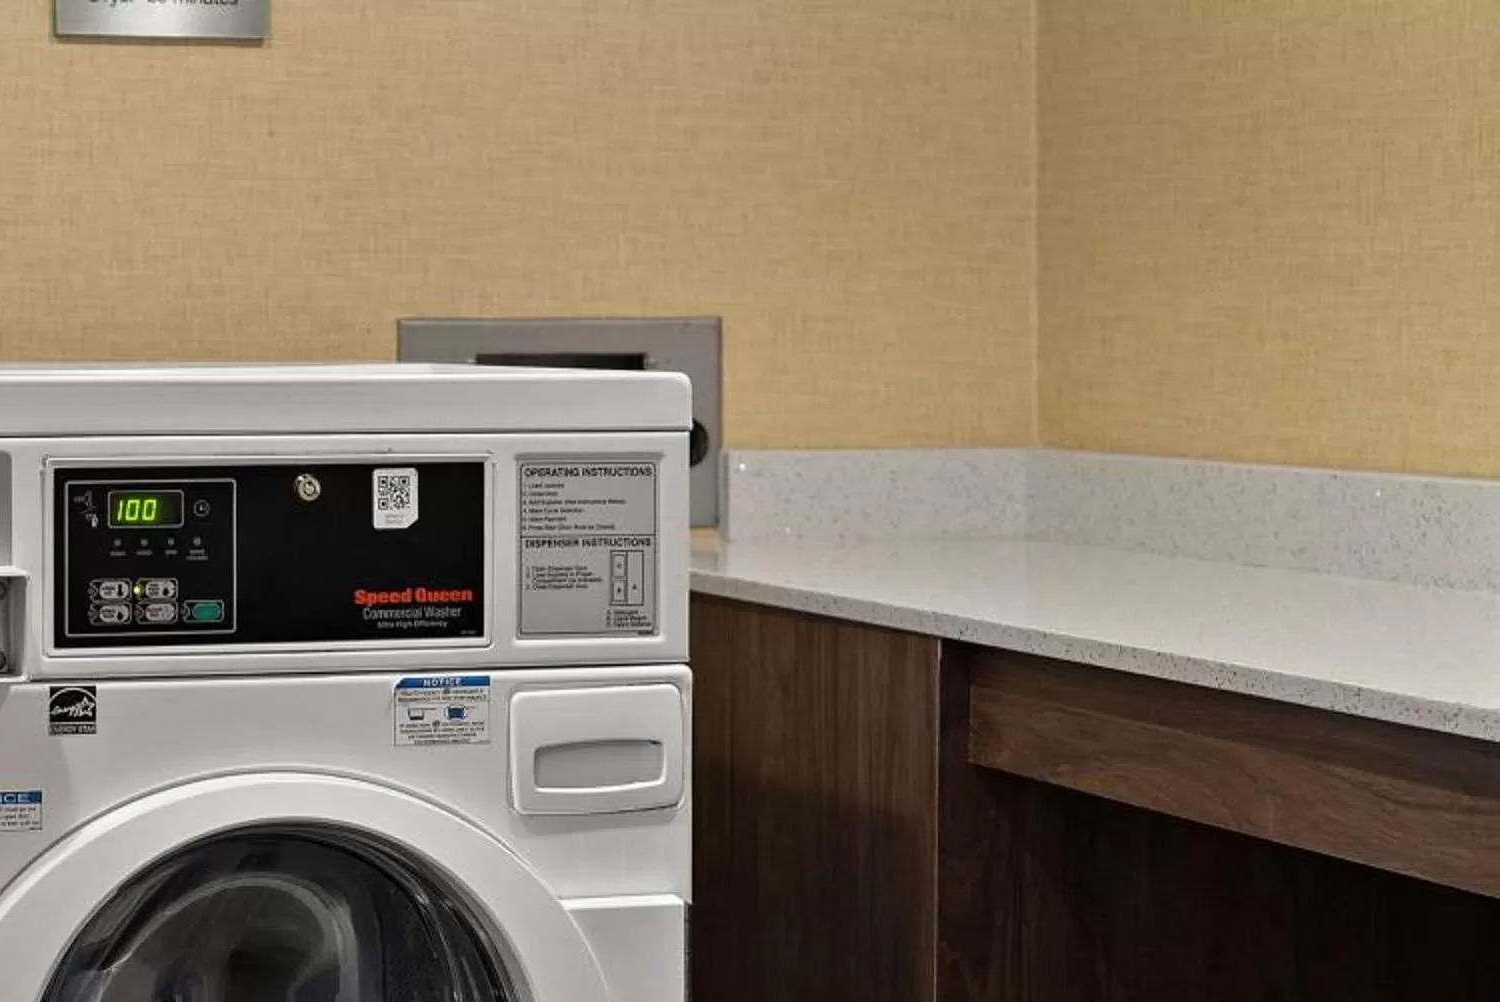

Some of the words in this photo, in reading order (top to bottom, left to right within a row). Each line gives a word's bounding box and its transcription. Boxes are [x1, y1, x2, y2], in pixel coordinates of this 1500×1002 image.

[524, 467, 580, 477] OPERATING
[582, 466, 653, 477] INSTRUCTIONS
[117, 499, 157, 521] 100
[354, 588, 412, 607] Speed
[415, 586, 473, 603] Queen
[362, 606, 422, 620] Commercial
[424, 604, 462, 618] Washer
